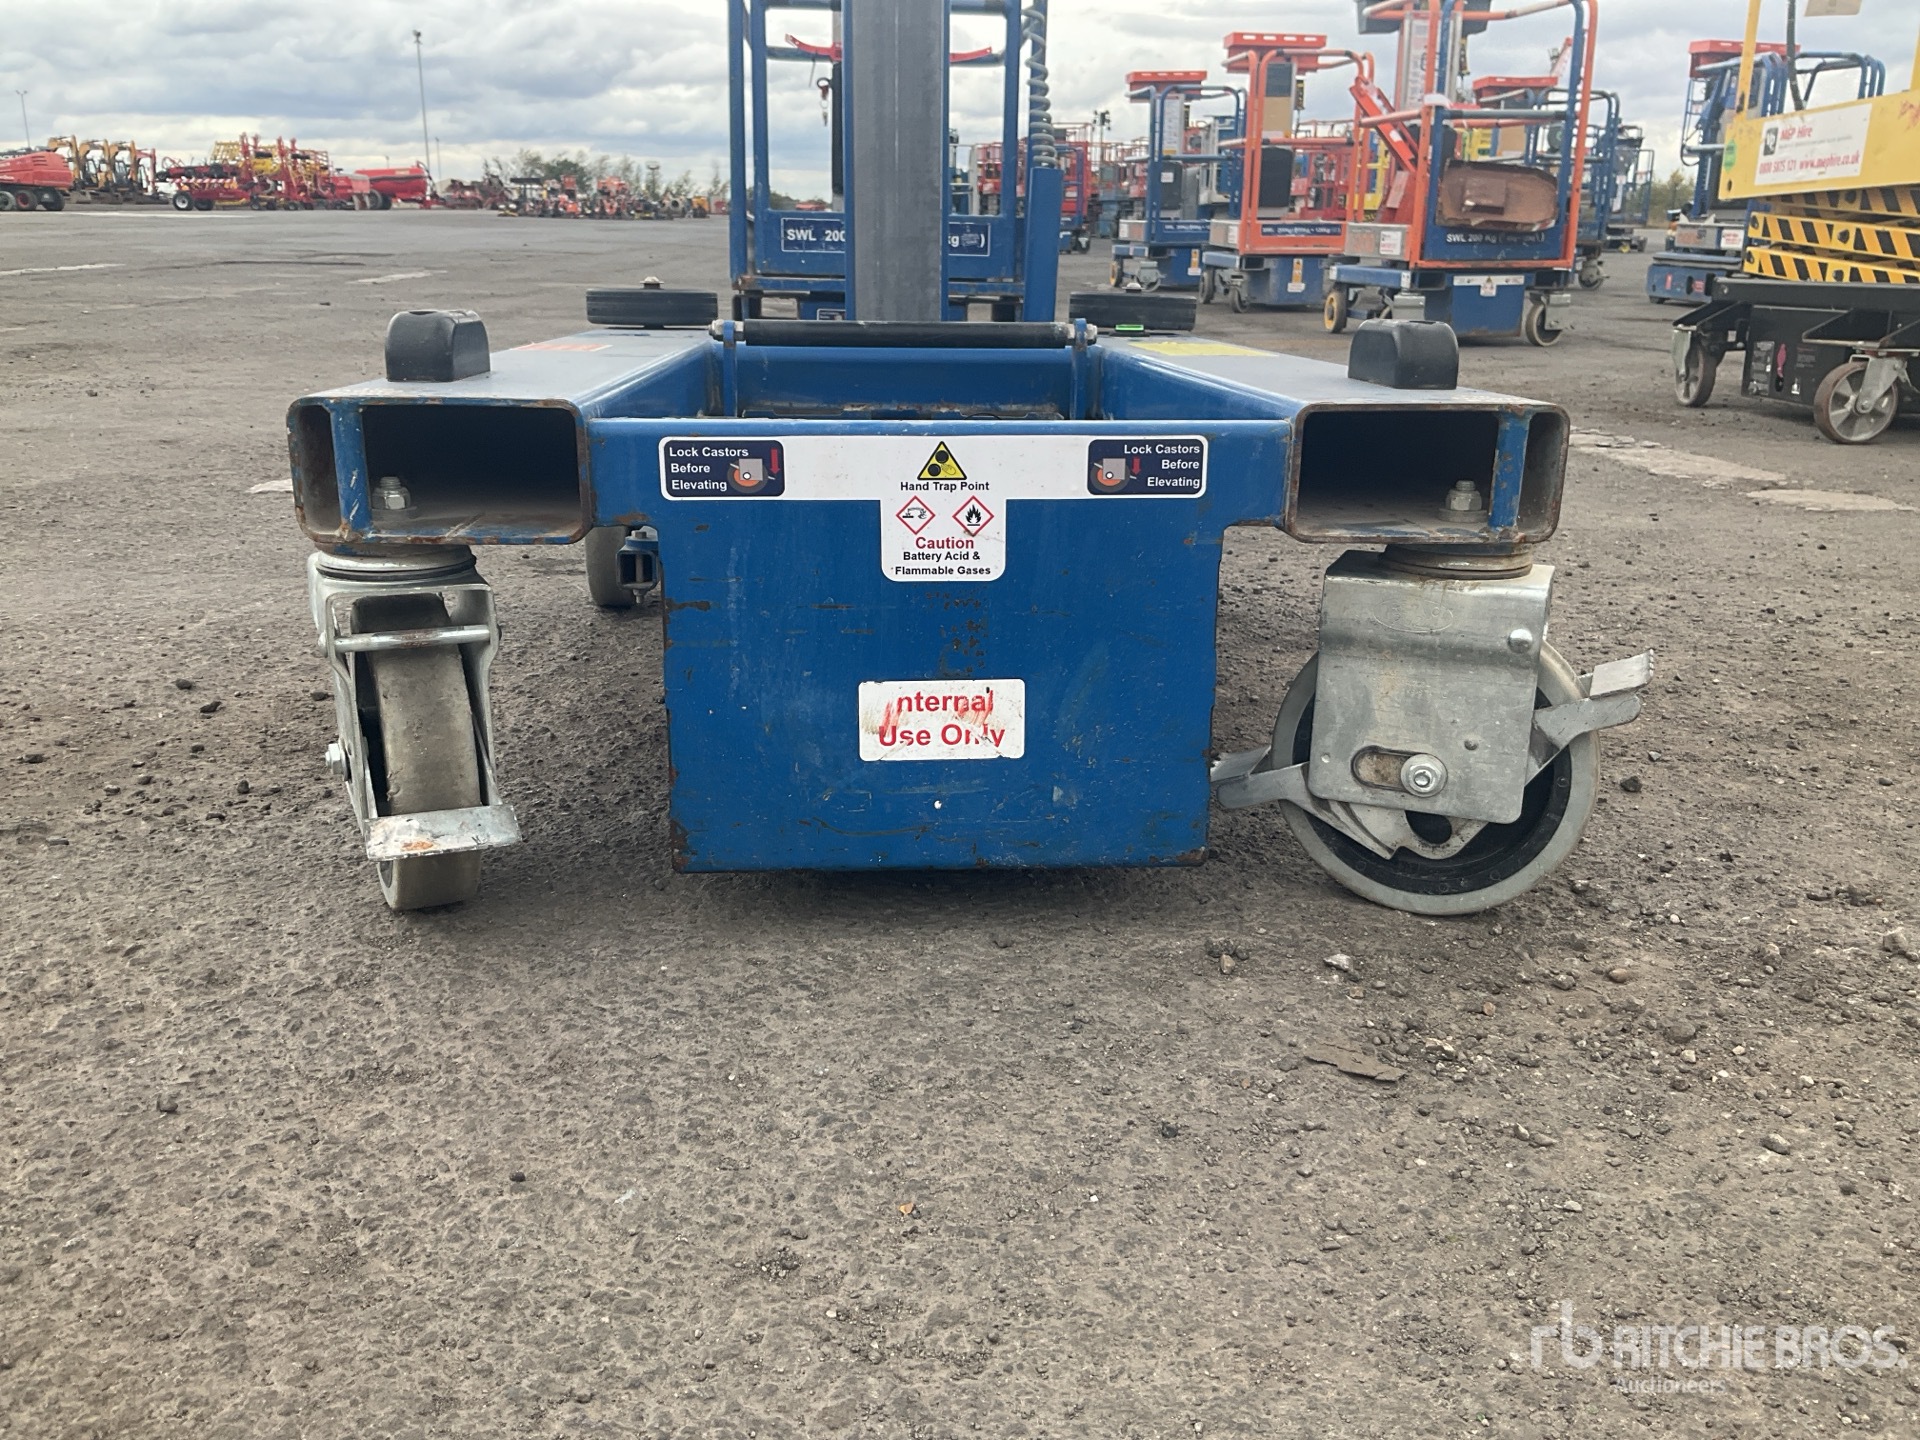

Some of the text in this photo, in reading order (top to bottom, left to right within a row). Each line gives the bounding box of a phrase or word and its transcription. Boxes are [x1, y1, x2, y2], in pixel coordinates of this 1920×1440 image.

[787, 229, 817, 241] SWL
[669, 446, 749, 457] Lock Castors
[1124, 444, 1200, 455] Lock Castors
[670, 463, 711, 474] Before
[1161, 459, 1200, 470] Before
[671, 479, 728, 492] Elevating
[900, 481, 990, 493] Hand Trap Point
[1147, 476, 1200, 489] Elevating
[915, 536, 974, 549] Caution
[903, 551, 981, 562] Battery Acid &
[895, 566, 991, 575] Flammable Gases
[878, 725, 931, 747] Use
